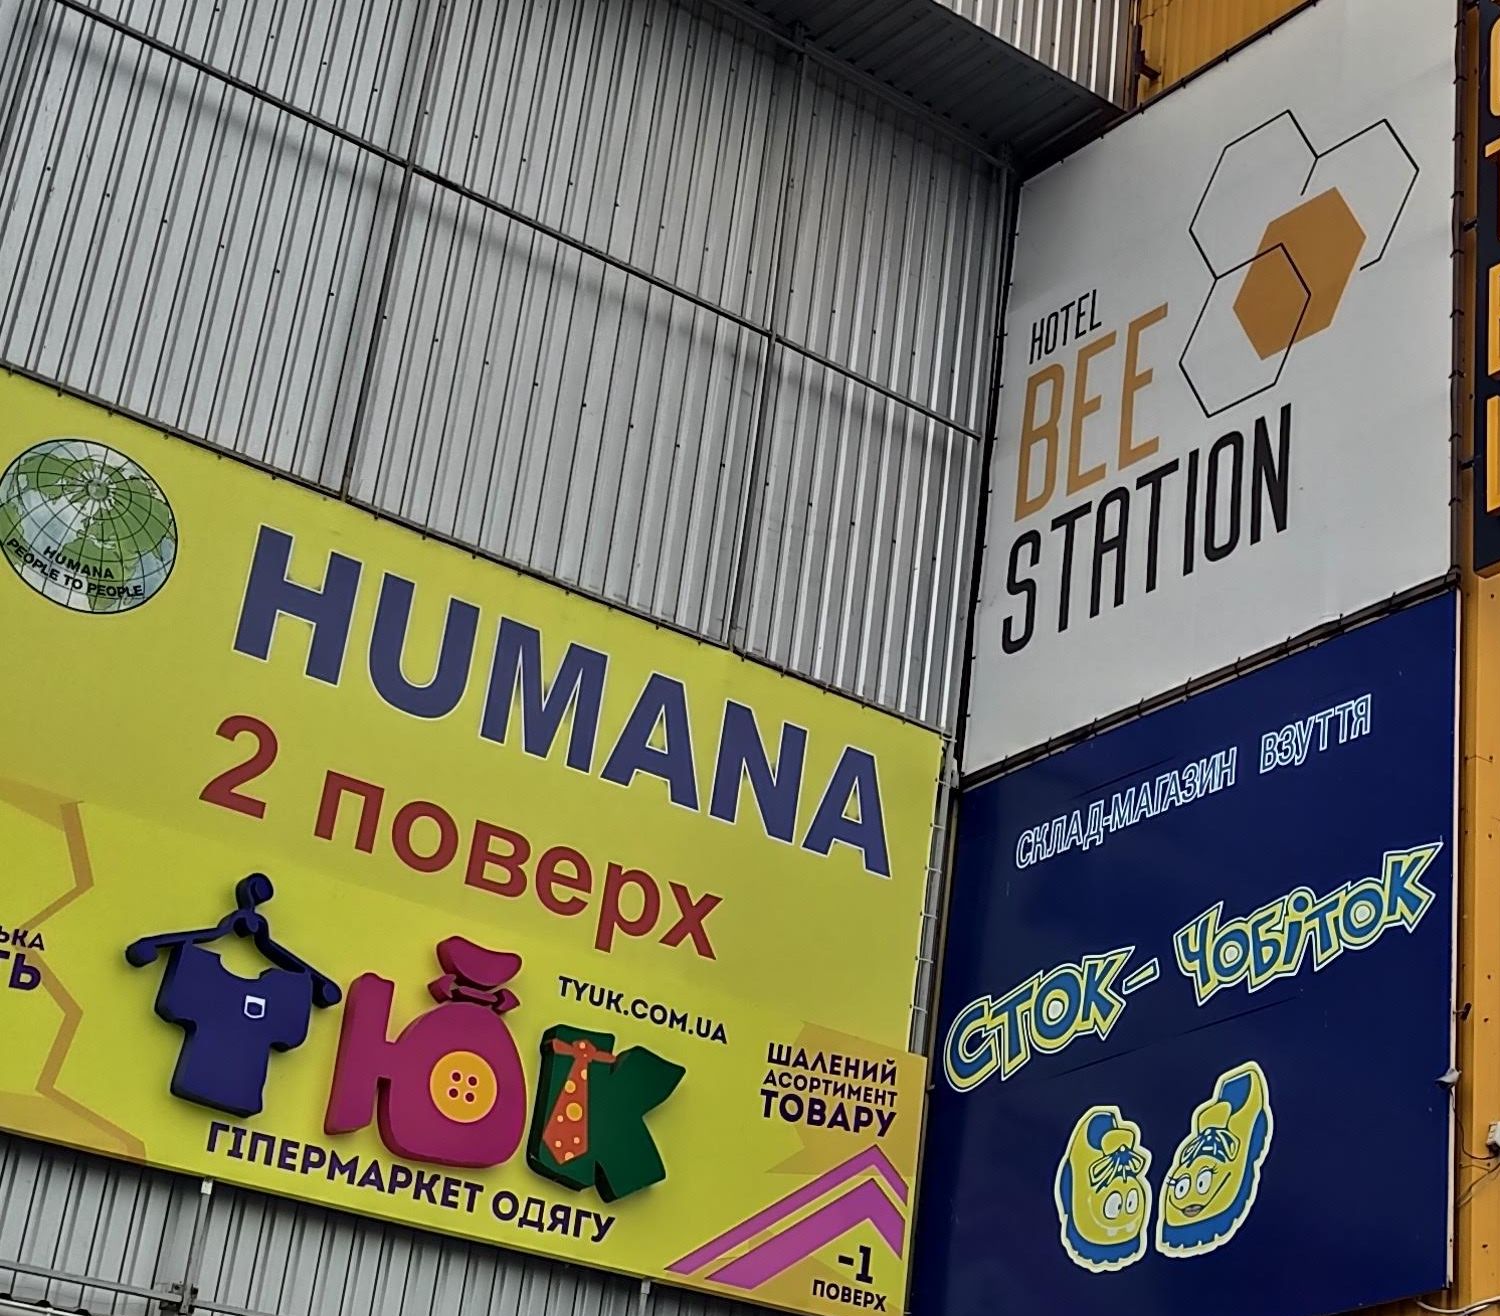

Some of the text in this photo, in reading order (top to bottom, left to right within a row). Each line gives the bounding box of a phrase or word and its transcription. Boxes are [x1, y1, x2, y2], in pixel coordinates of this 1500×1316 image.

[1029, 289, 1102, 365] HOTEL
[1014, 302, 1169, 523] BEE
[43, 545, 115, 580] HUMANA
[1002, 403, 1292, 655] STATION
[7, 537, 144, 598] PEOPLE TO PEOPLE
[233, 524, 891, 878] HUMANA
[1015, 694, 1372, 870] СКЛАД-МАГАЗИН ВЗУТТЯ
[199, 714, 725, 962] 2 поверх
[558, 975, 729, 1046] TYUK.COM.UA
[762, 1067, 899, 1110] АСОРТИМЕНТ
[767, 1041, 899, 1087] ШАЛЕНИЙ
[760, 1088, 898, 1138] ТОВАРУ
[206, 1120, 617, 1243] ГІПЕРМАРКЕТ ОДЯГУ
[811, 1278, 888, 1313] ПОВЕРХ
